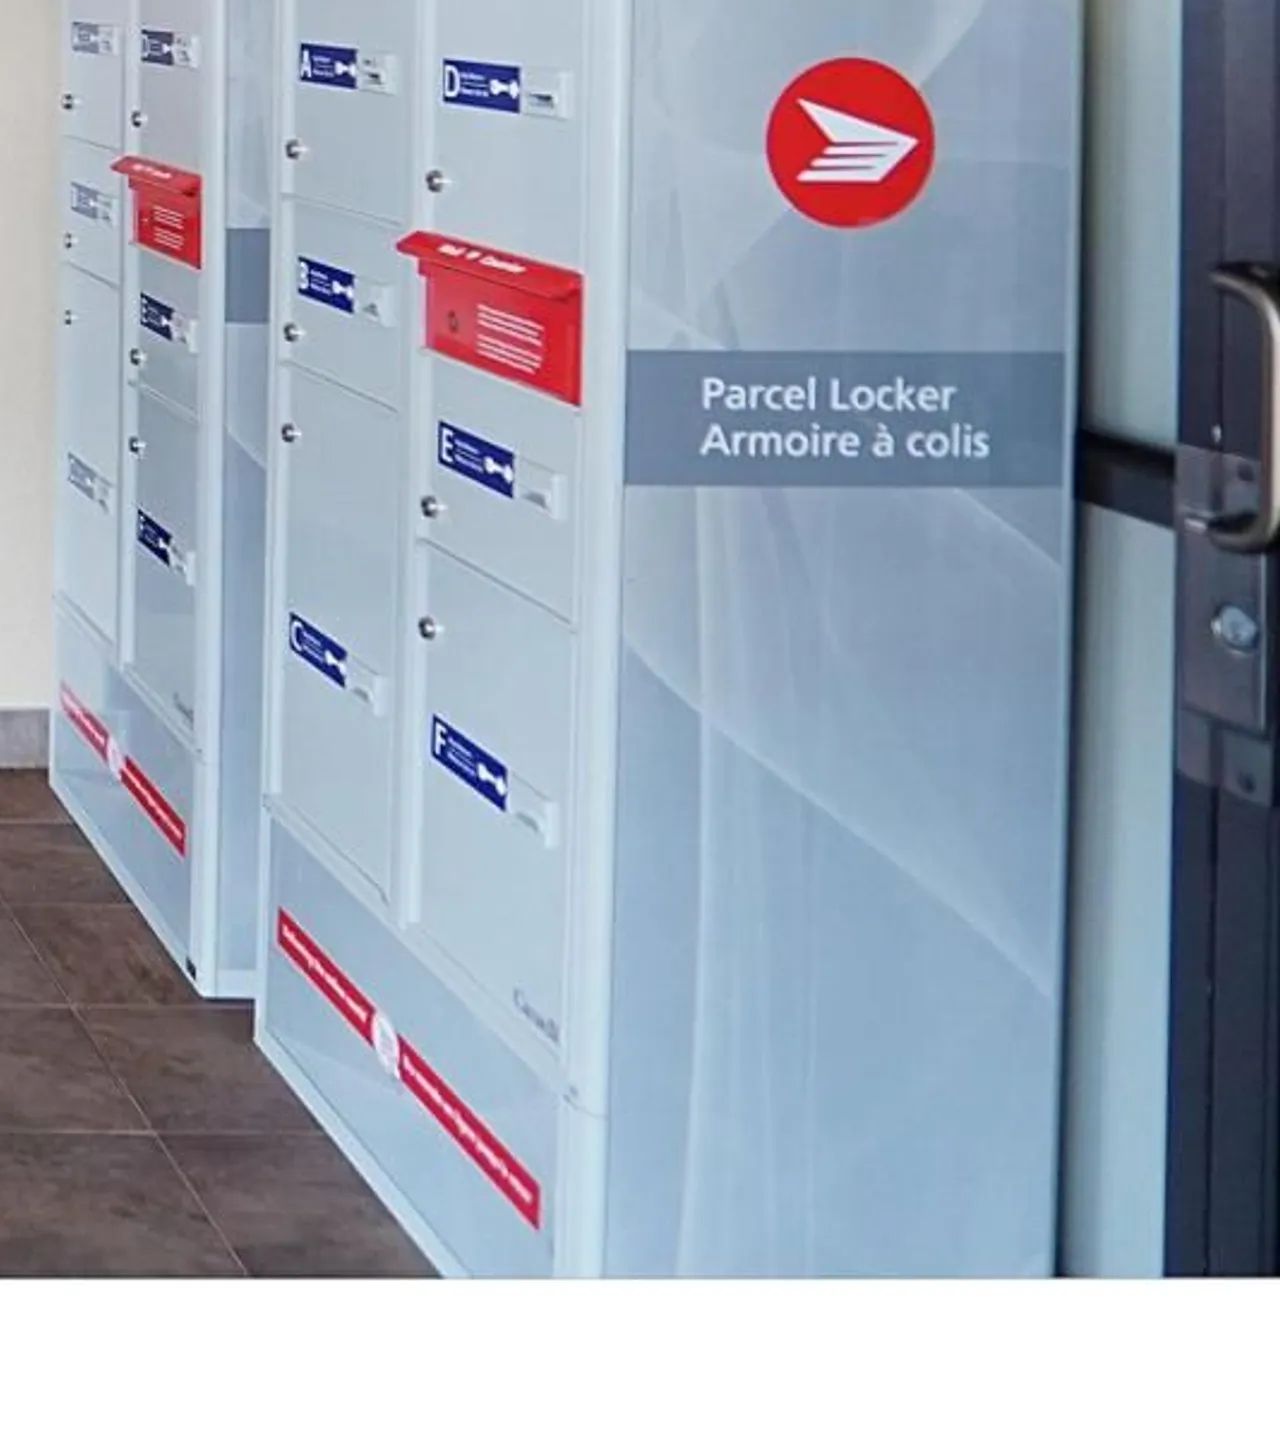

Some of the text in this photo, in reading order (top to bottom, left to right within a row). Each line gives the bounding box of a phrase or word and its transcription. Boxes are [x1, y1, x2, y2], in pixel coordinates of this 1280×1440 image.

[300, 49, 312, 79] A
[444, 64, 460, 98] D
[701, 376, 958, 412] Parcel Locker
[441, 426, 454, 463] E
[699, 423, 991, 459] Armoire à colis
[291, 620, 303, 652] C
[434, 722, 447, 756] F
